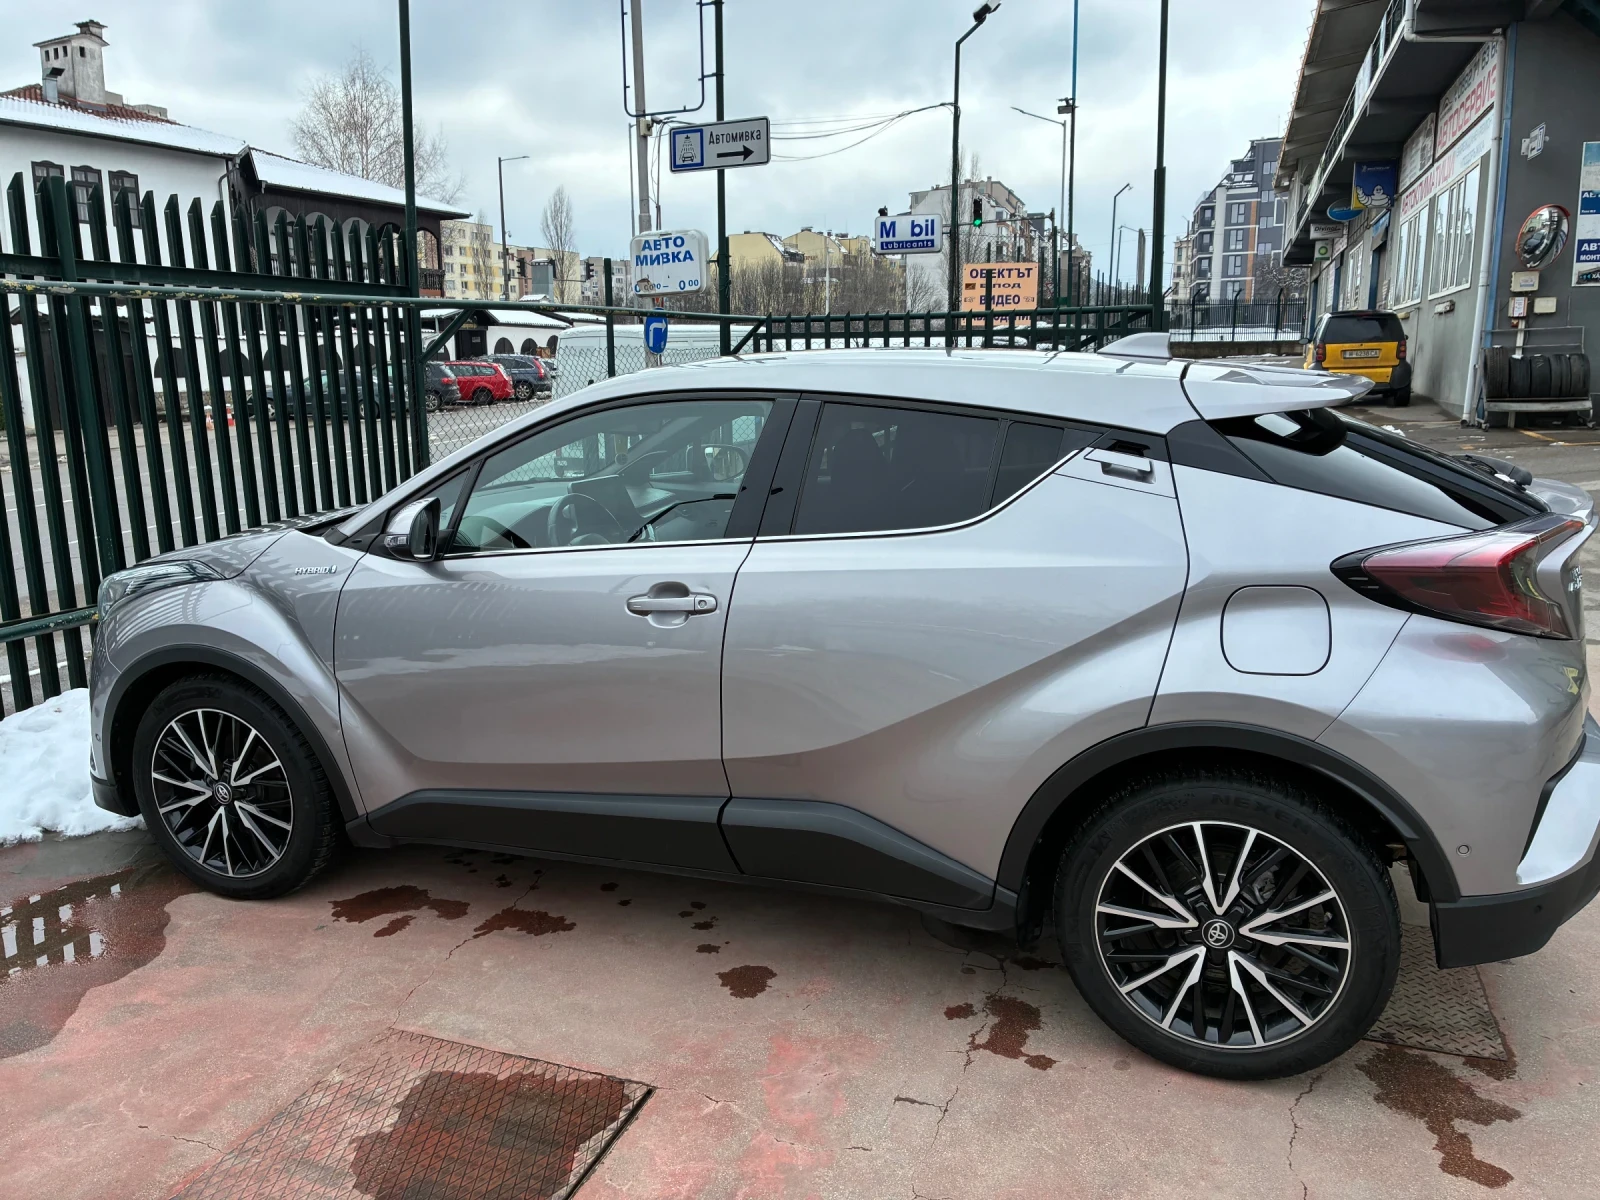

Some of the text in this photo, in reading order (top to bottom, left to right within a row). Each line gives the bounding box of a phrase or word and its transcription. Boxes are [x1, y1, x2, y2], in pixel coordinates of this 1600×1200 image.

[709, 130, 761, 145] Автомивка
[880, 219, 935, 238] Mbil
[641, 236, 685, 251] АВТО
[883, 241, 932, 249] Lubricants
[635, 250, 694, 266] МИВКА
[295, 566, 330, 575] HYBRID
[1211, 793, 1313, 835] NEXEN
